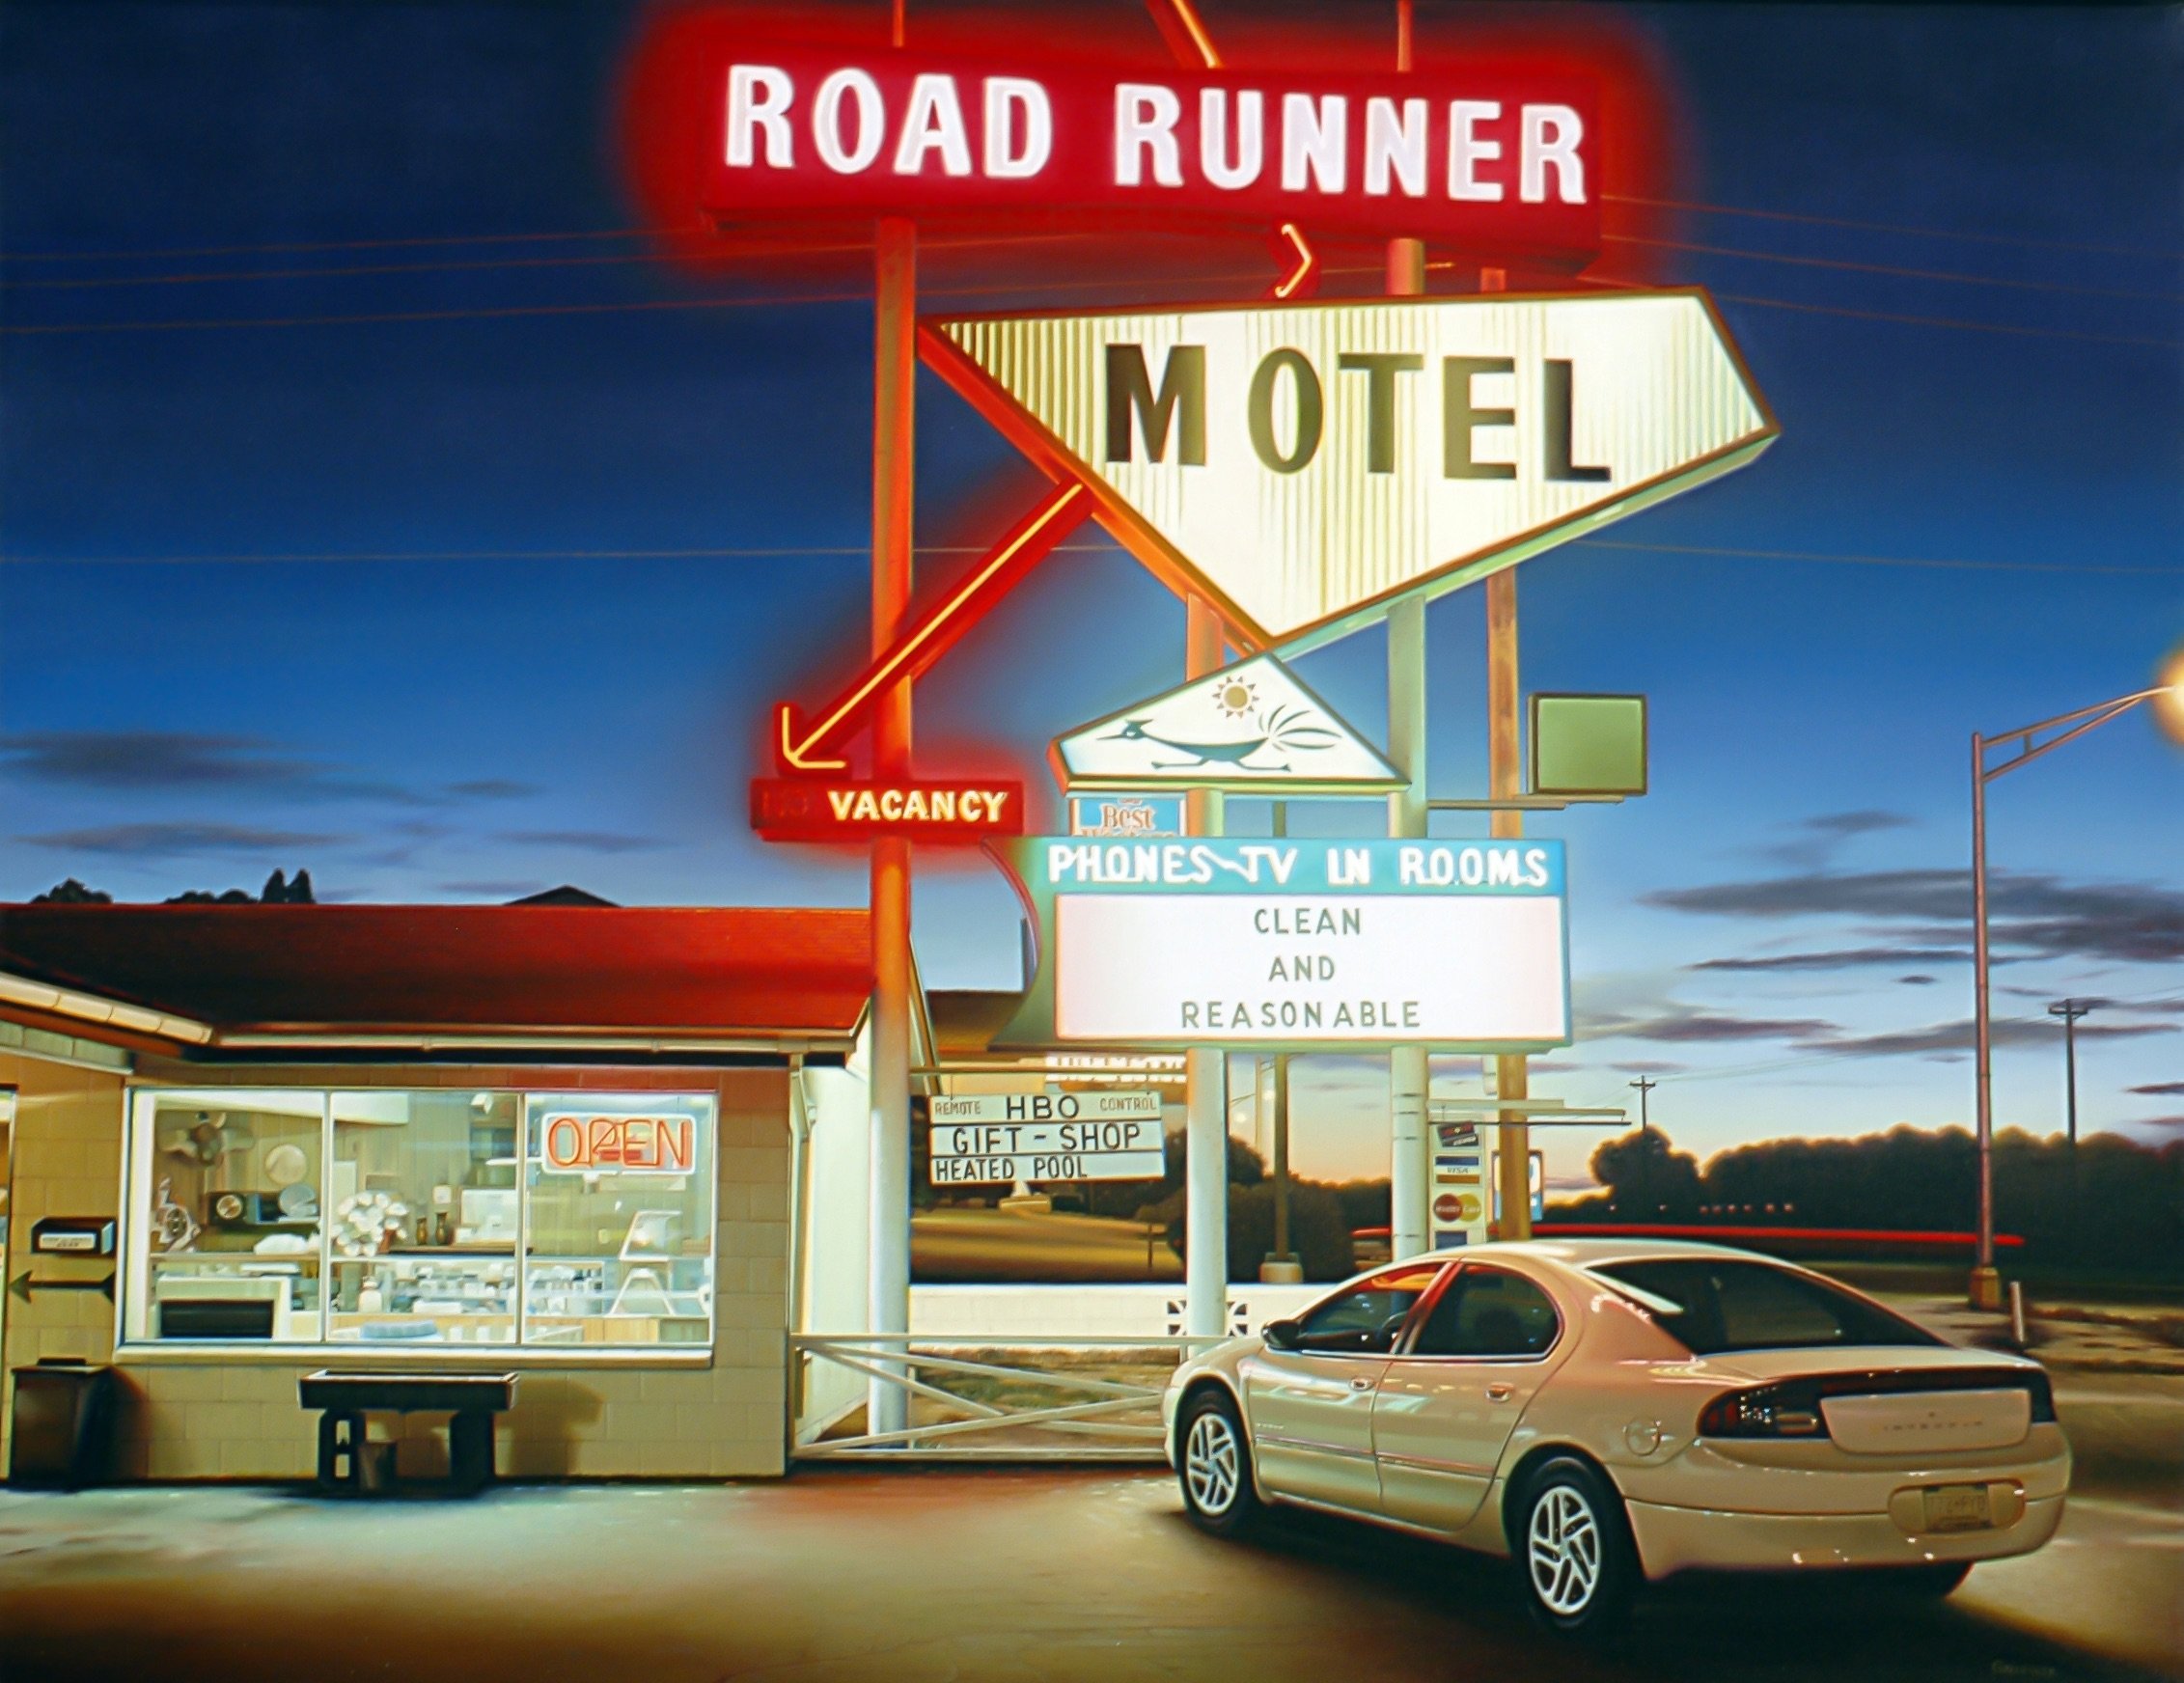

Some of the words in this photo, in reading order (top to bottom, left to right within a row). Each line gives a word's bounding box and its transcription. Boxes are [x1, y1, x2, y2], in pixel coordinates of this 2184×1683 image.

[726, 64, 1052, 179] ROAD
[1115, 83, 1588, 204] RUNNER
[1105, 343, 1612, 482] MOTEL
[827, 789, 1008, 821] VACANCY
[1102, 804, 1153, 829] Best
[1327, 848, 1370, 885] IN
[1399, 847, 1548, 887] ROOMS
[1254, 908, 1362, 935] CLEAN
[1268, 955, 1336, 982] AND
[1181, 1001, 1421, 1028] REASONABLE
[934, 1100, 981, 1116] REMOTE
[1006, 1095, 1079, 1119] HBO
[1099, 1097, 1157, 1112] CONTROL
[547, 1117, 693, 1168] OPEN
[936, 1158, 1014, 1181] HEATED
[1034, 1156, 1088, 1179] POOL
